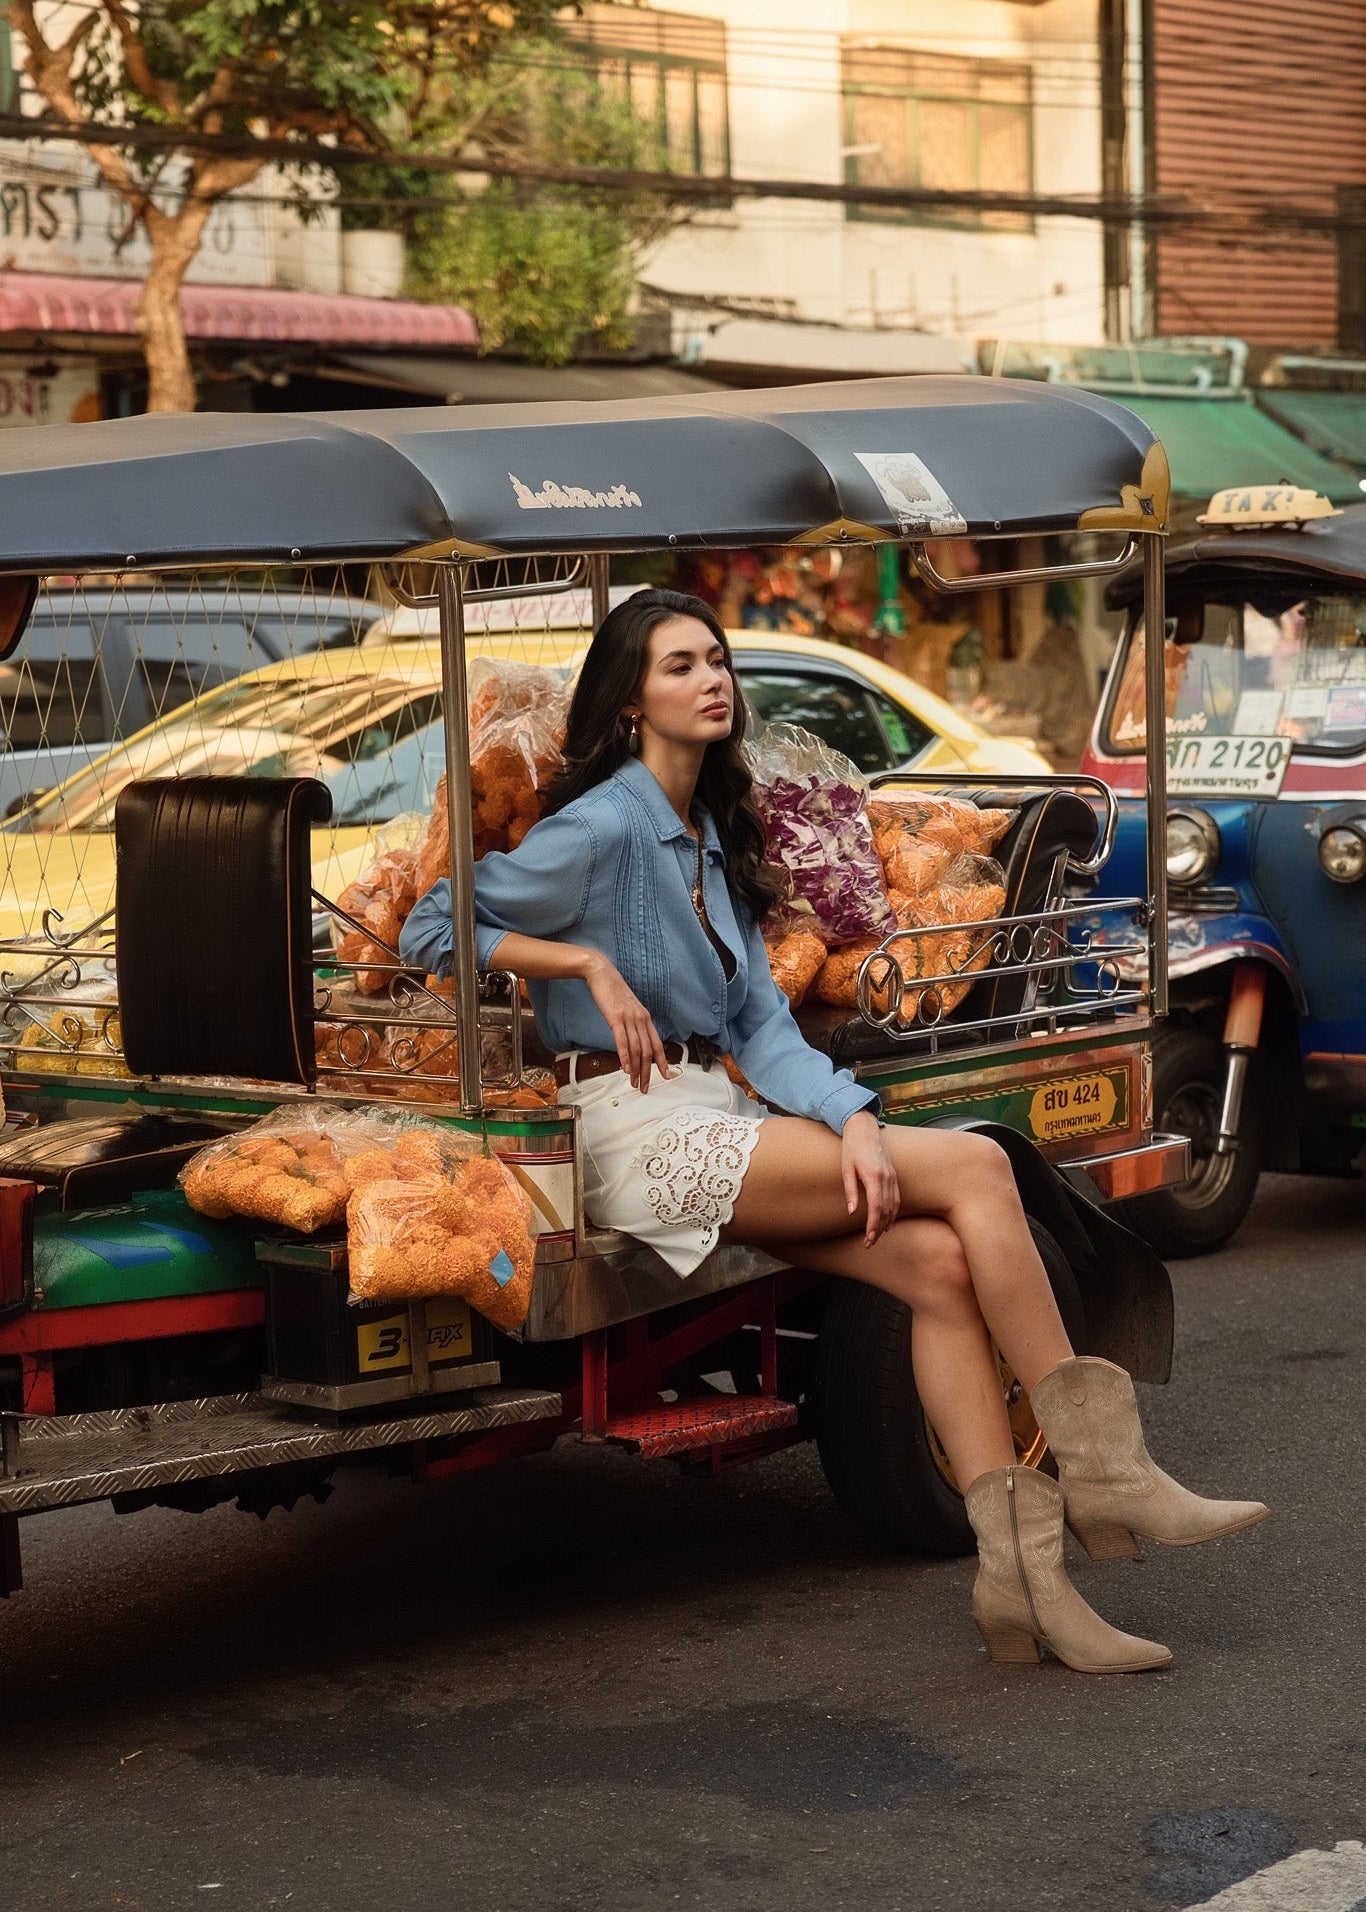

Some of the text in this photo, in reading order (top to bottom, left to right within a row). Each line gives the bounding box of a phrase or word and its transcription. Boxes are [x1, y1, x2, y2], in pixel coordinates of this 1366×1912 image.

[1209, 740, 1283, 770] 2120
[1044, 1082, 1100, 1111] สข 424
[1044, 1112, 1102, 1135] กรุงเทพมหานคร
